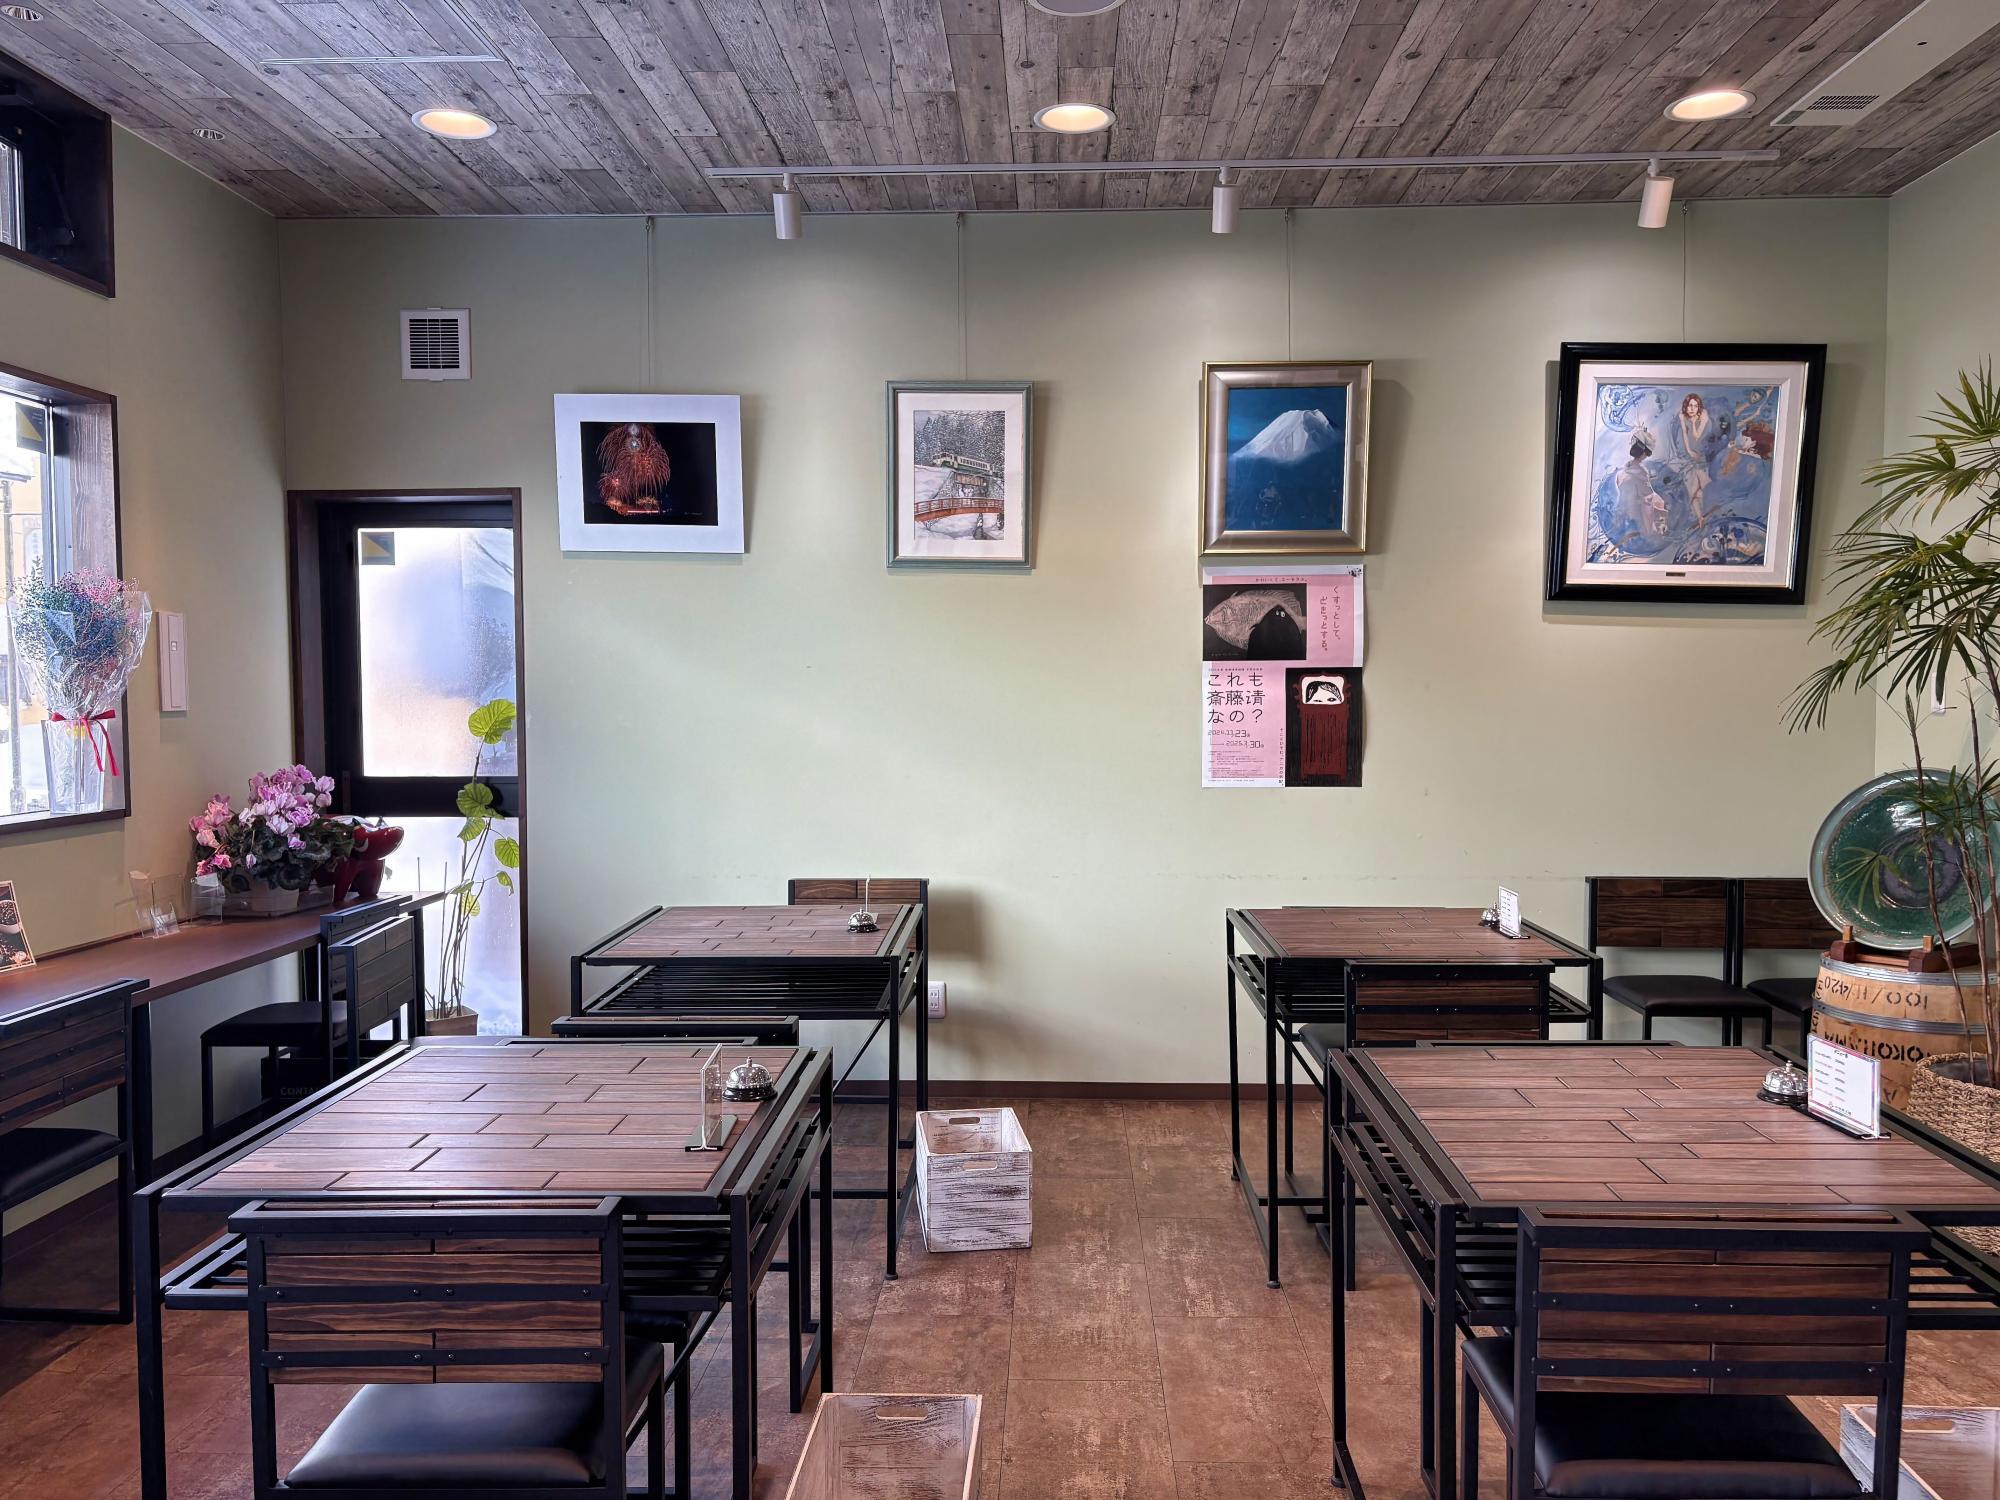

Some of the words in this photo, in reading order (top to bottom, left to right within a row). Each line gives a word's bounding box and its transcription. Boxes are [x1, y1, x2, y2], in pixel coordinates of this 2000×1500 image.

[1332, 586, 1341, 640] くすっとして、
[1208, 671, 1264, 687] これも
[1206, 690, 1266, 706] 斎藤清
[1207, 708, 1263, 724] なの？
[280, 1087, 319, 1096] CONTA
